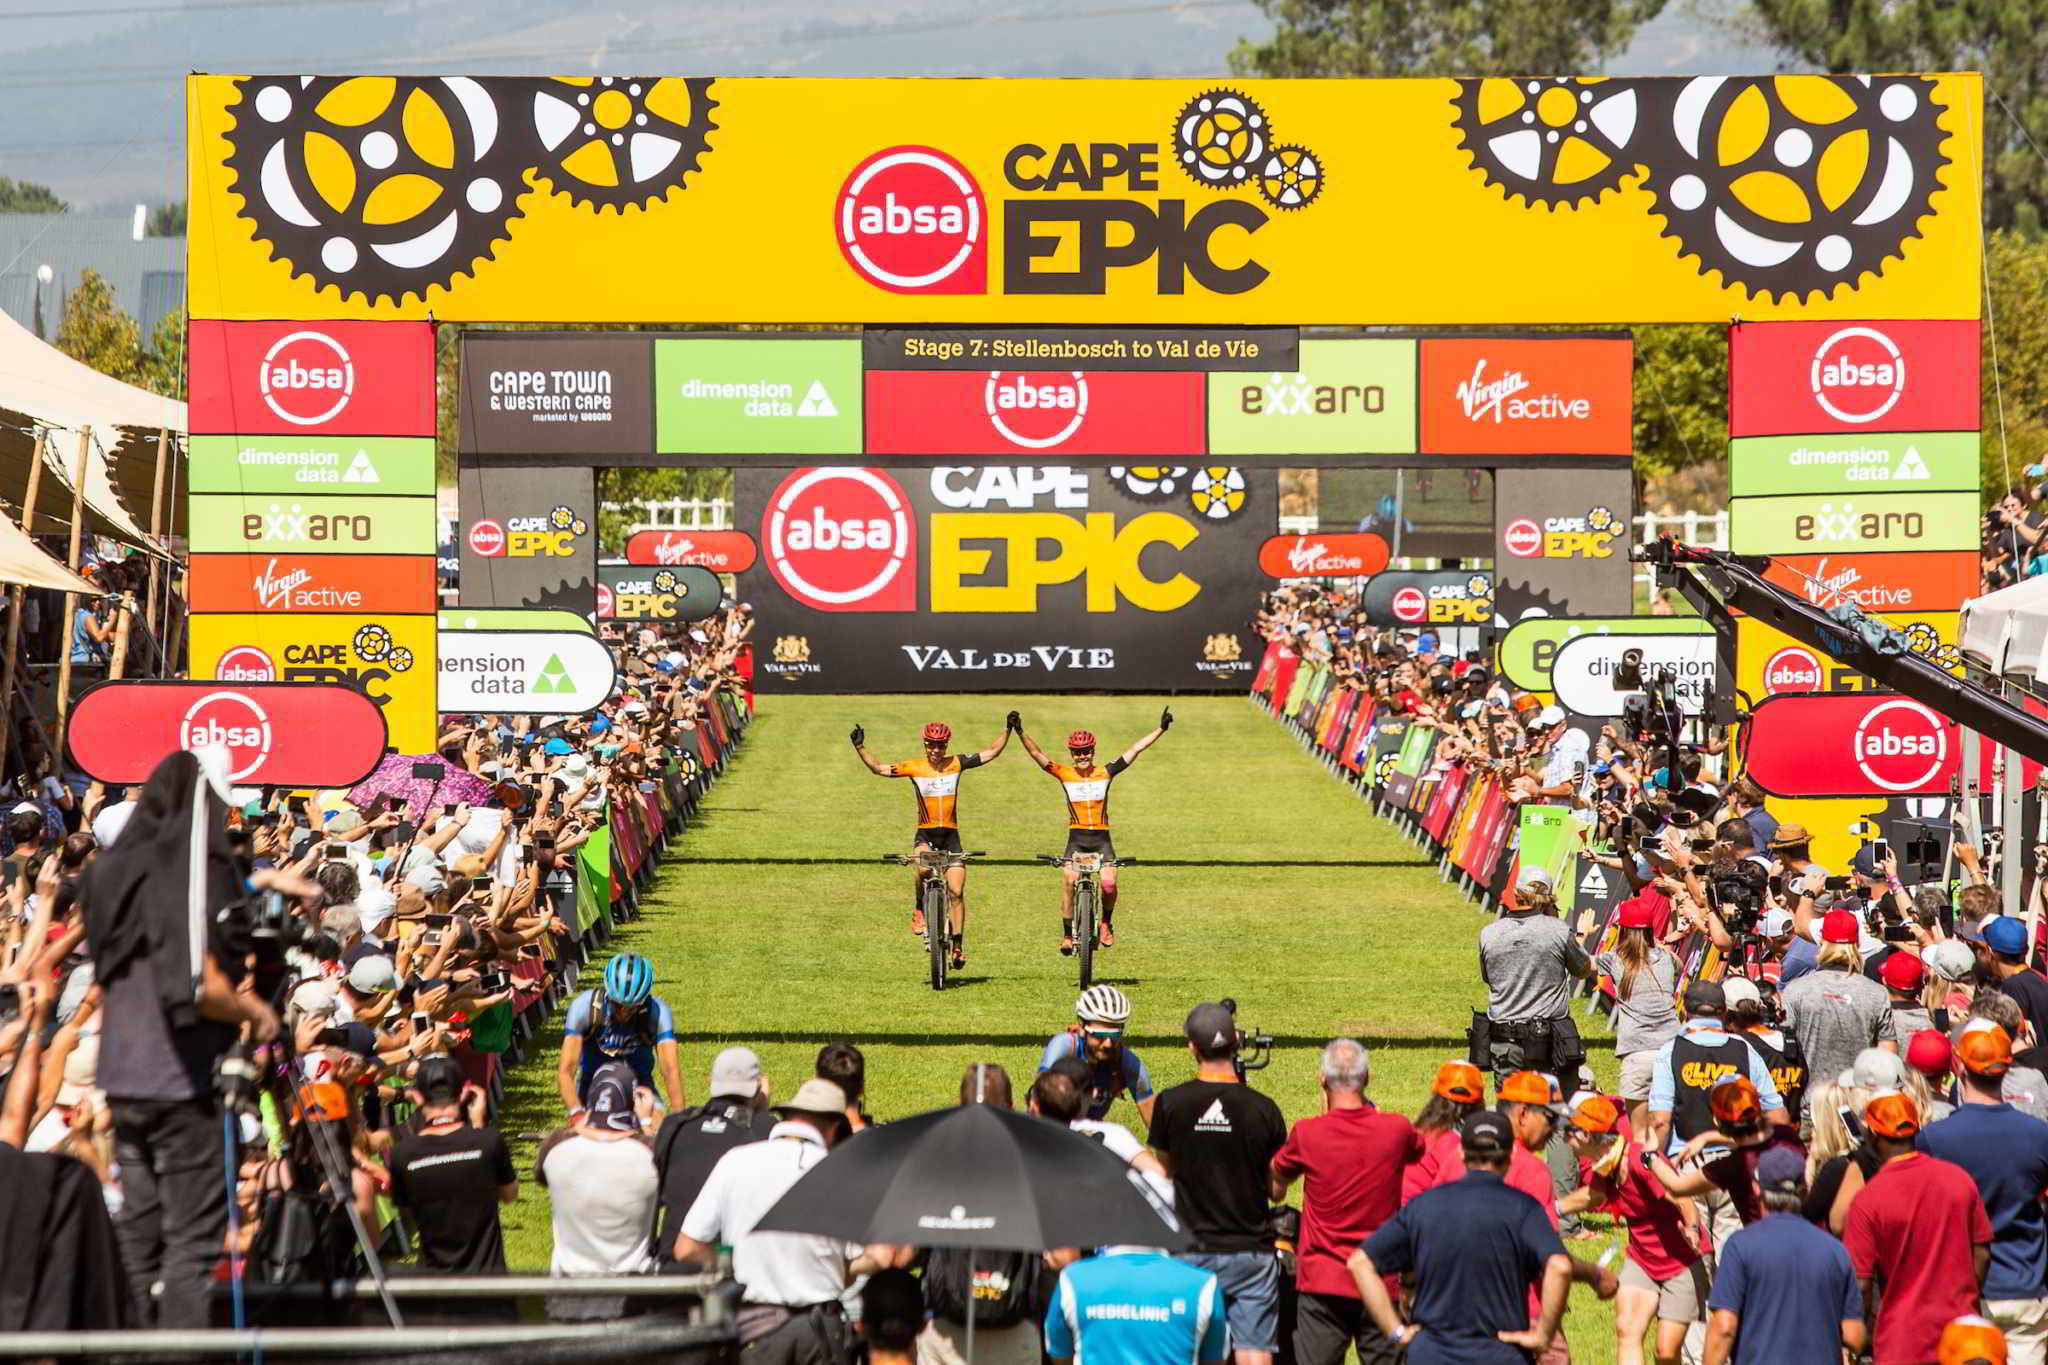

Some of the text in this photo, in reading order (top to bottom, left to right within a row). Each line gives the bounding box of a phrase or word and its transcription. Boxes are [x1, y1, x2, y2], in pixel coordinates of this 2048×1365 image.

[1003, 143, 1159, 192] CAPE
[859, 192, 964, 235] absa
[1003, 199, 1271, 295] EPIC
[904, 338, 1260, 361] Stage 7: Stellenbosch to Val de Vie
[271, 359, 343, 389] absa
[551, 370, 612, 394] TOWN
[1823, 355, 1893, 386] absa
[681, 380, 793, 399] dimension
[998, 376, 1077, 410] absa
[1241, 374, 1385, 415] exxaro
[1456, 359, 1529, 424] Virgin
[490, 394, 501, 411] &
[745, 400, 793, 418] data
[1506, 394, 1590, 419] active
[532, 413, 568, 422] marketed
[569, 413, 579, 423] by
[237, 448, 339, 466] dimension
[1789, 448, 1889, 465] dimension
[295, 467, 339, 483] data
[1845, 465, 1889, 481] data
[930, 466, 1089, 508] CAPE
[243, 503, 371, 542] exxaro
[507, 517, 548, 532] CAPE
[787, 506, 893, 551] absa
[1544, 517, 1586, 532] CAPE
[1795, 503, 1923, 541] exxaro
[473, 530, 500, 543] absa
[507, 531, 576, 557] EPIC
[654, 532, 695, 565] Virgin
[1543, 532, 1614, 558] EPIC
[680, 551, 729, 565] active
[930, 511, 1202, 613] EPIC
[1287, 536, 1329, 573] Virgin
[1316, 554, 1363, 570] active
[253, 558, 313, 609] Virgin
[615, 580, 653, 594] CAPE
[1428, 585, 1467, 599] CAPE
[1803, 557, 1862, 608] Virgin
[294, 586, 362, 607] active
[615, 593, 678, 618] EPIC
[1847, 584, 1913, 606] active
[1428, 598, 1490, 623] EPIC
[284, 644, 347, 665] CAPE
[901, 645, 1115, 671] VAL DE VIE
[1587, 656, 1715, 677] diension
[224, 664, 268, 681] absa
[470, 674, 525, 694] data
[1772, 666, 1816, 685] absa
[191, 717, 261, 748] absa
[1865, 727, 1937, 755] absa
[1085, 1303, 1170, 1323] MEDICLINIC
